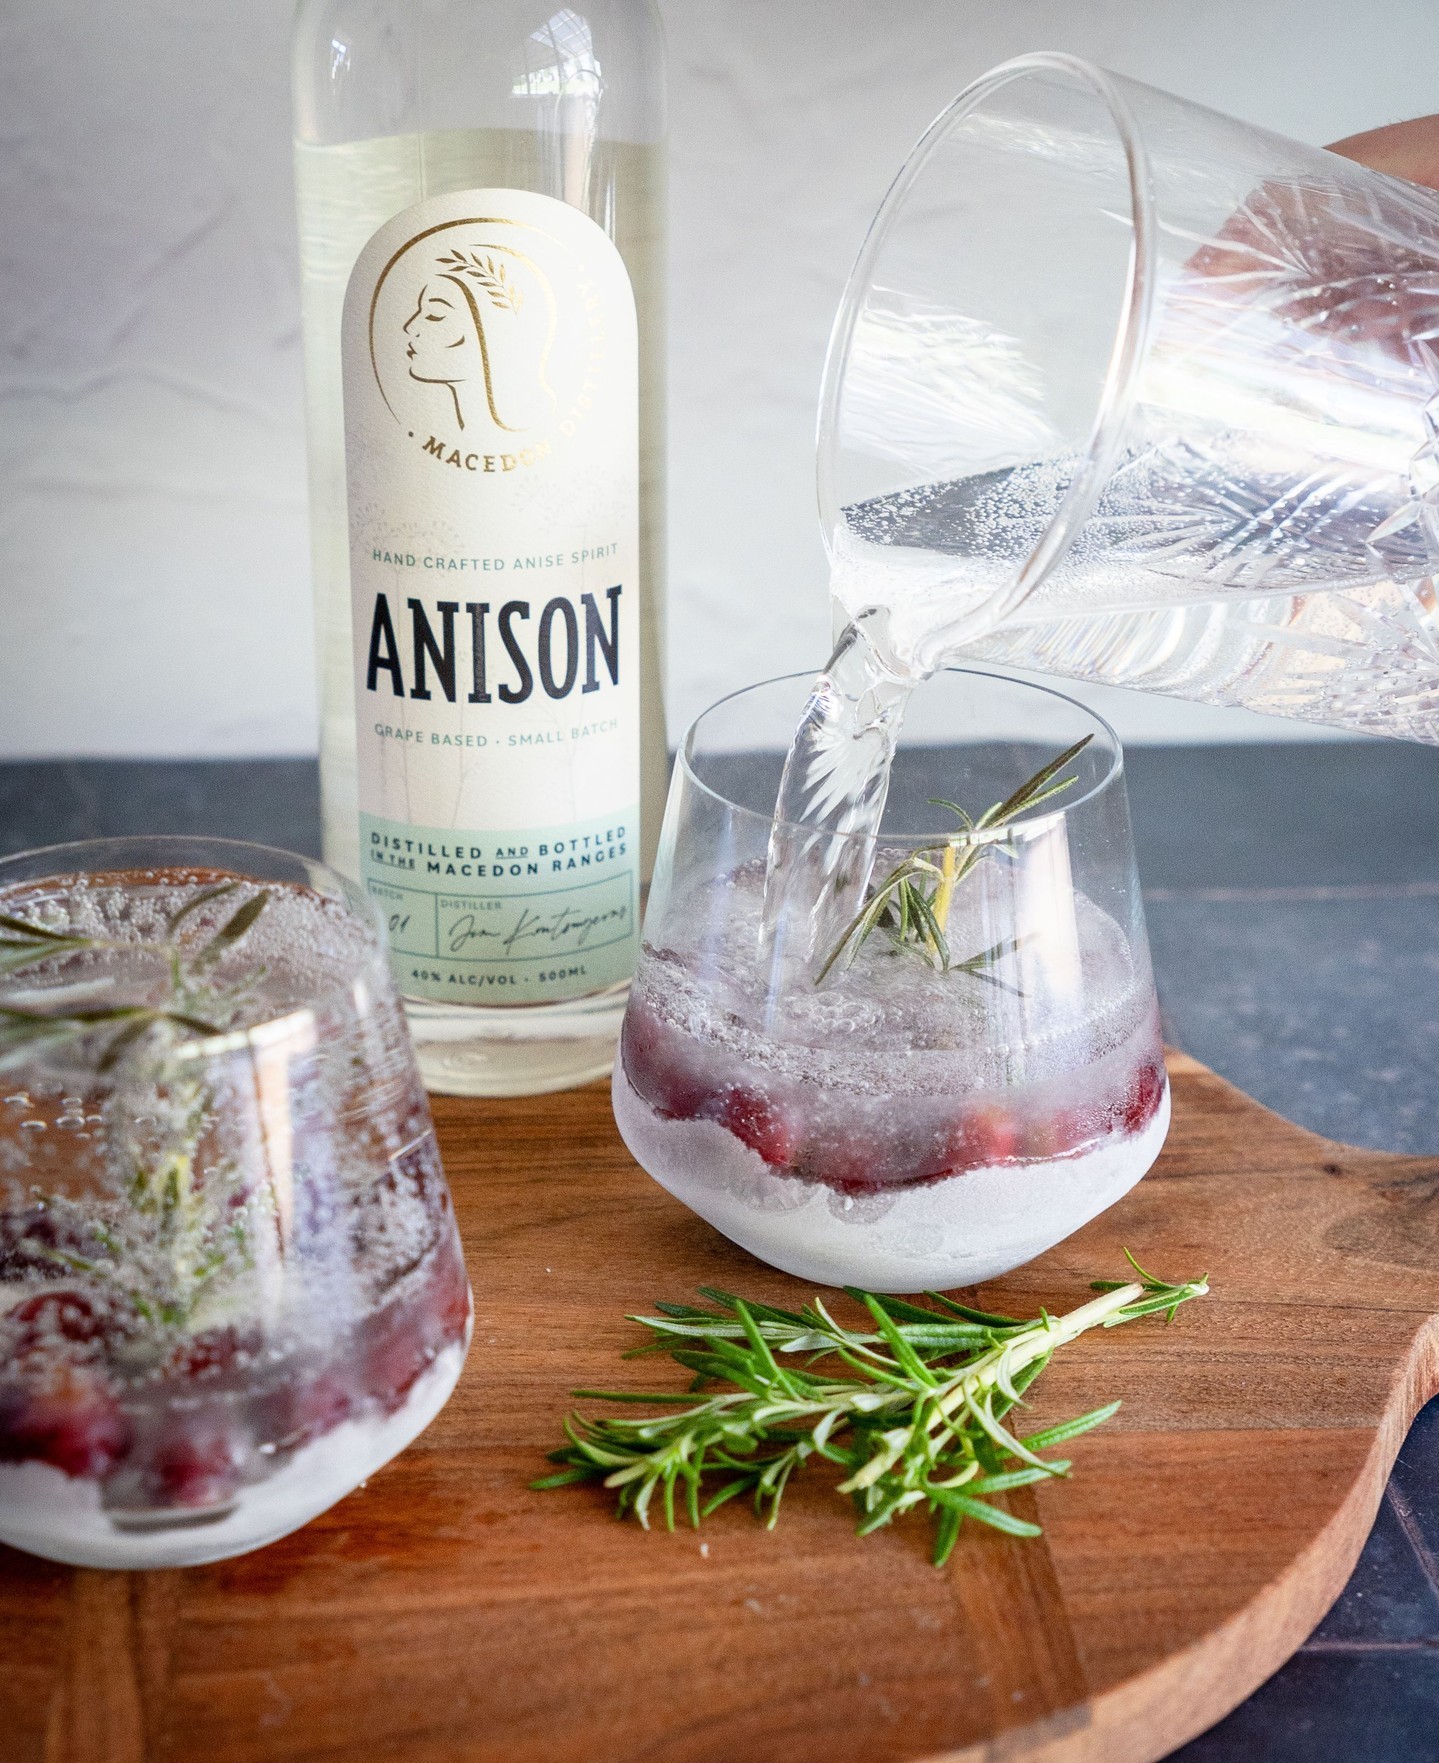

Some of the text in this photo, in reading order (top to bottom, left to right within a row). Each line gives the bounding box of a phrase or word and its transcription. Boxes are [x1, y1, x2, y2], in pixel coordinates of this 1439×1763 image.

[422, 436, 552, 473] MACEDON
[373, 542, 618, 571] HAND CRAFTED ANISE SPIRIT
[367, 584, 622, 704] ANISON
[374, 718, 618, 747] GRAPE BASED SMALL BATCH
[371, 826, 625, 859] DISTILLED AND BOTTLED
[371, 842, 626, 877] IN THE MACEDON RANGES
[440, 899, 502, 911] DISTILLER
[411, 964, 587, 987] 40% ALC/VOL 500ML
